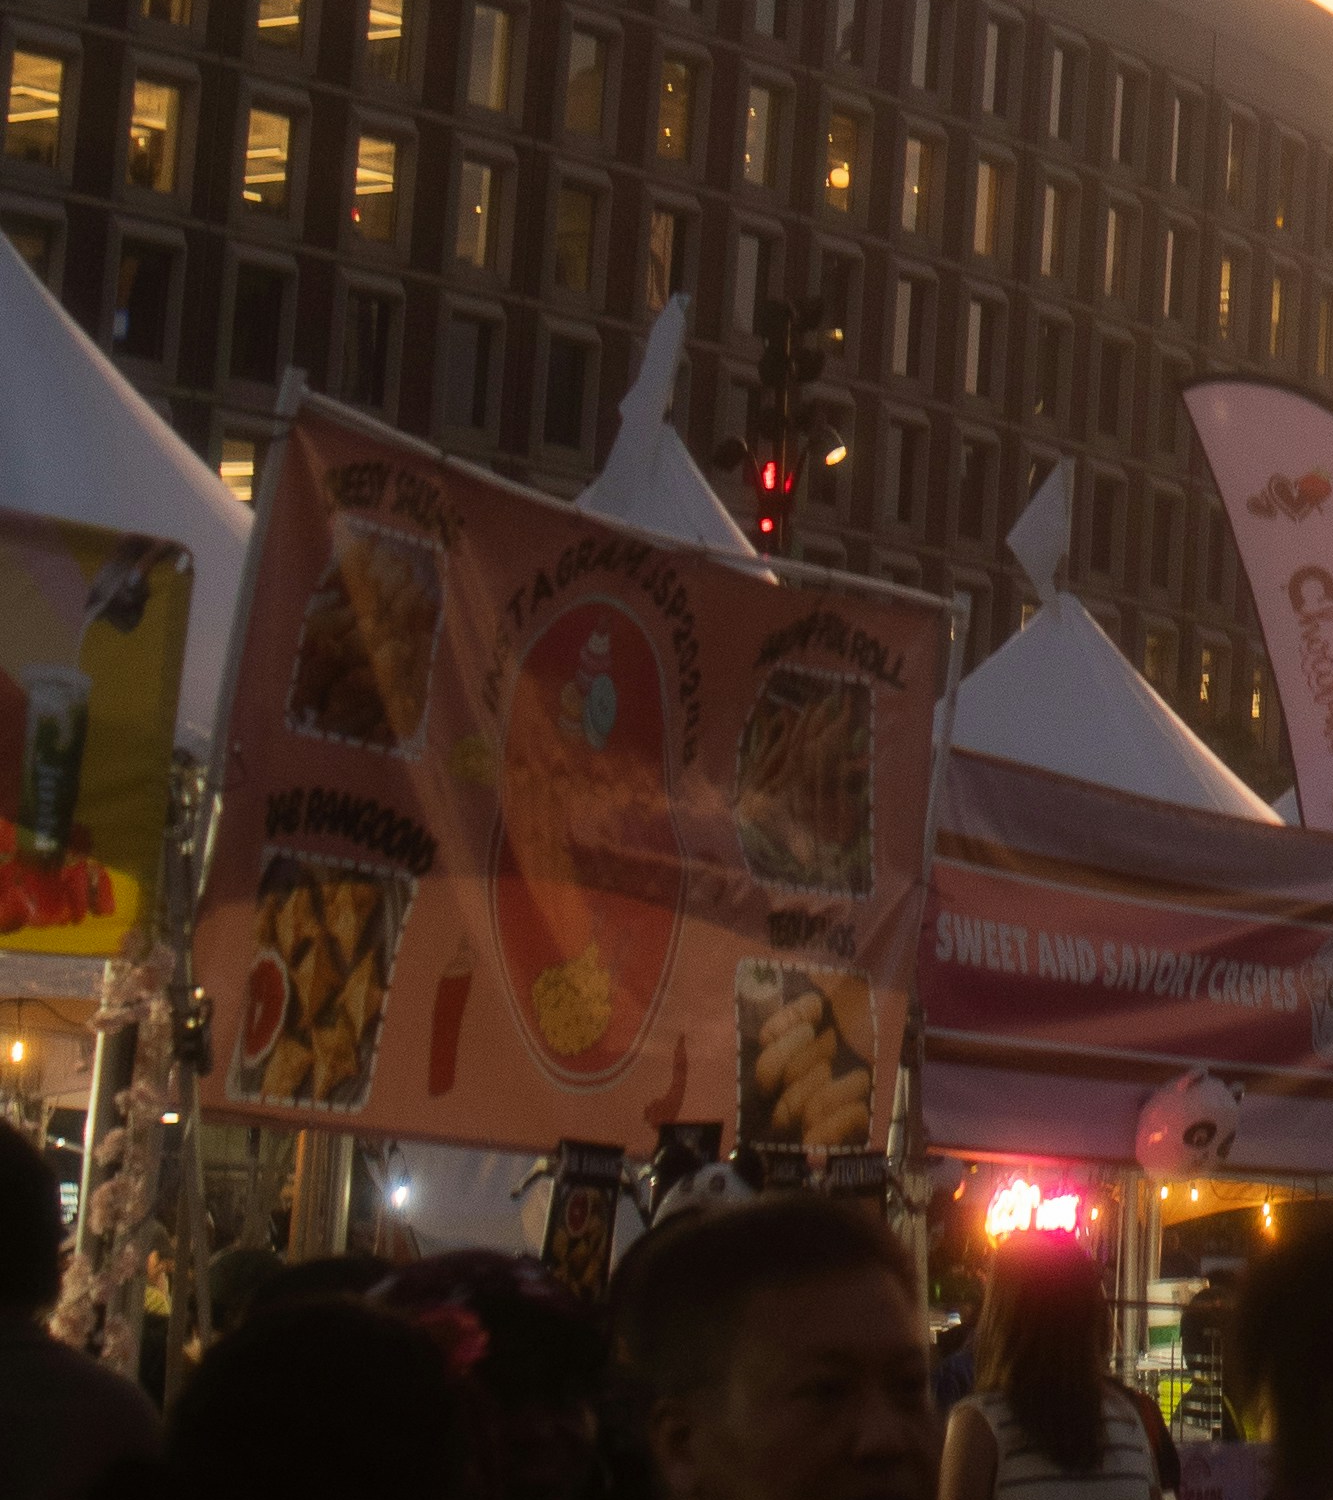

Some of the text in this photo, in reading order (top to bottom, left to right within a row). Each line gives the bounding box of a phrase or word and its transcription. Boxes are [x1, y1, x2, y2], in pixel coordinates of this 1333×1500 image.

[935, 909, 1299, 1013] SWEET AND SAVORY CREPES
